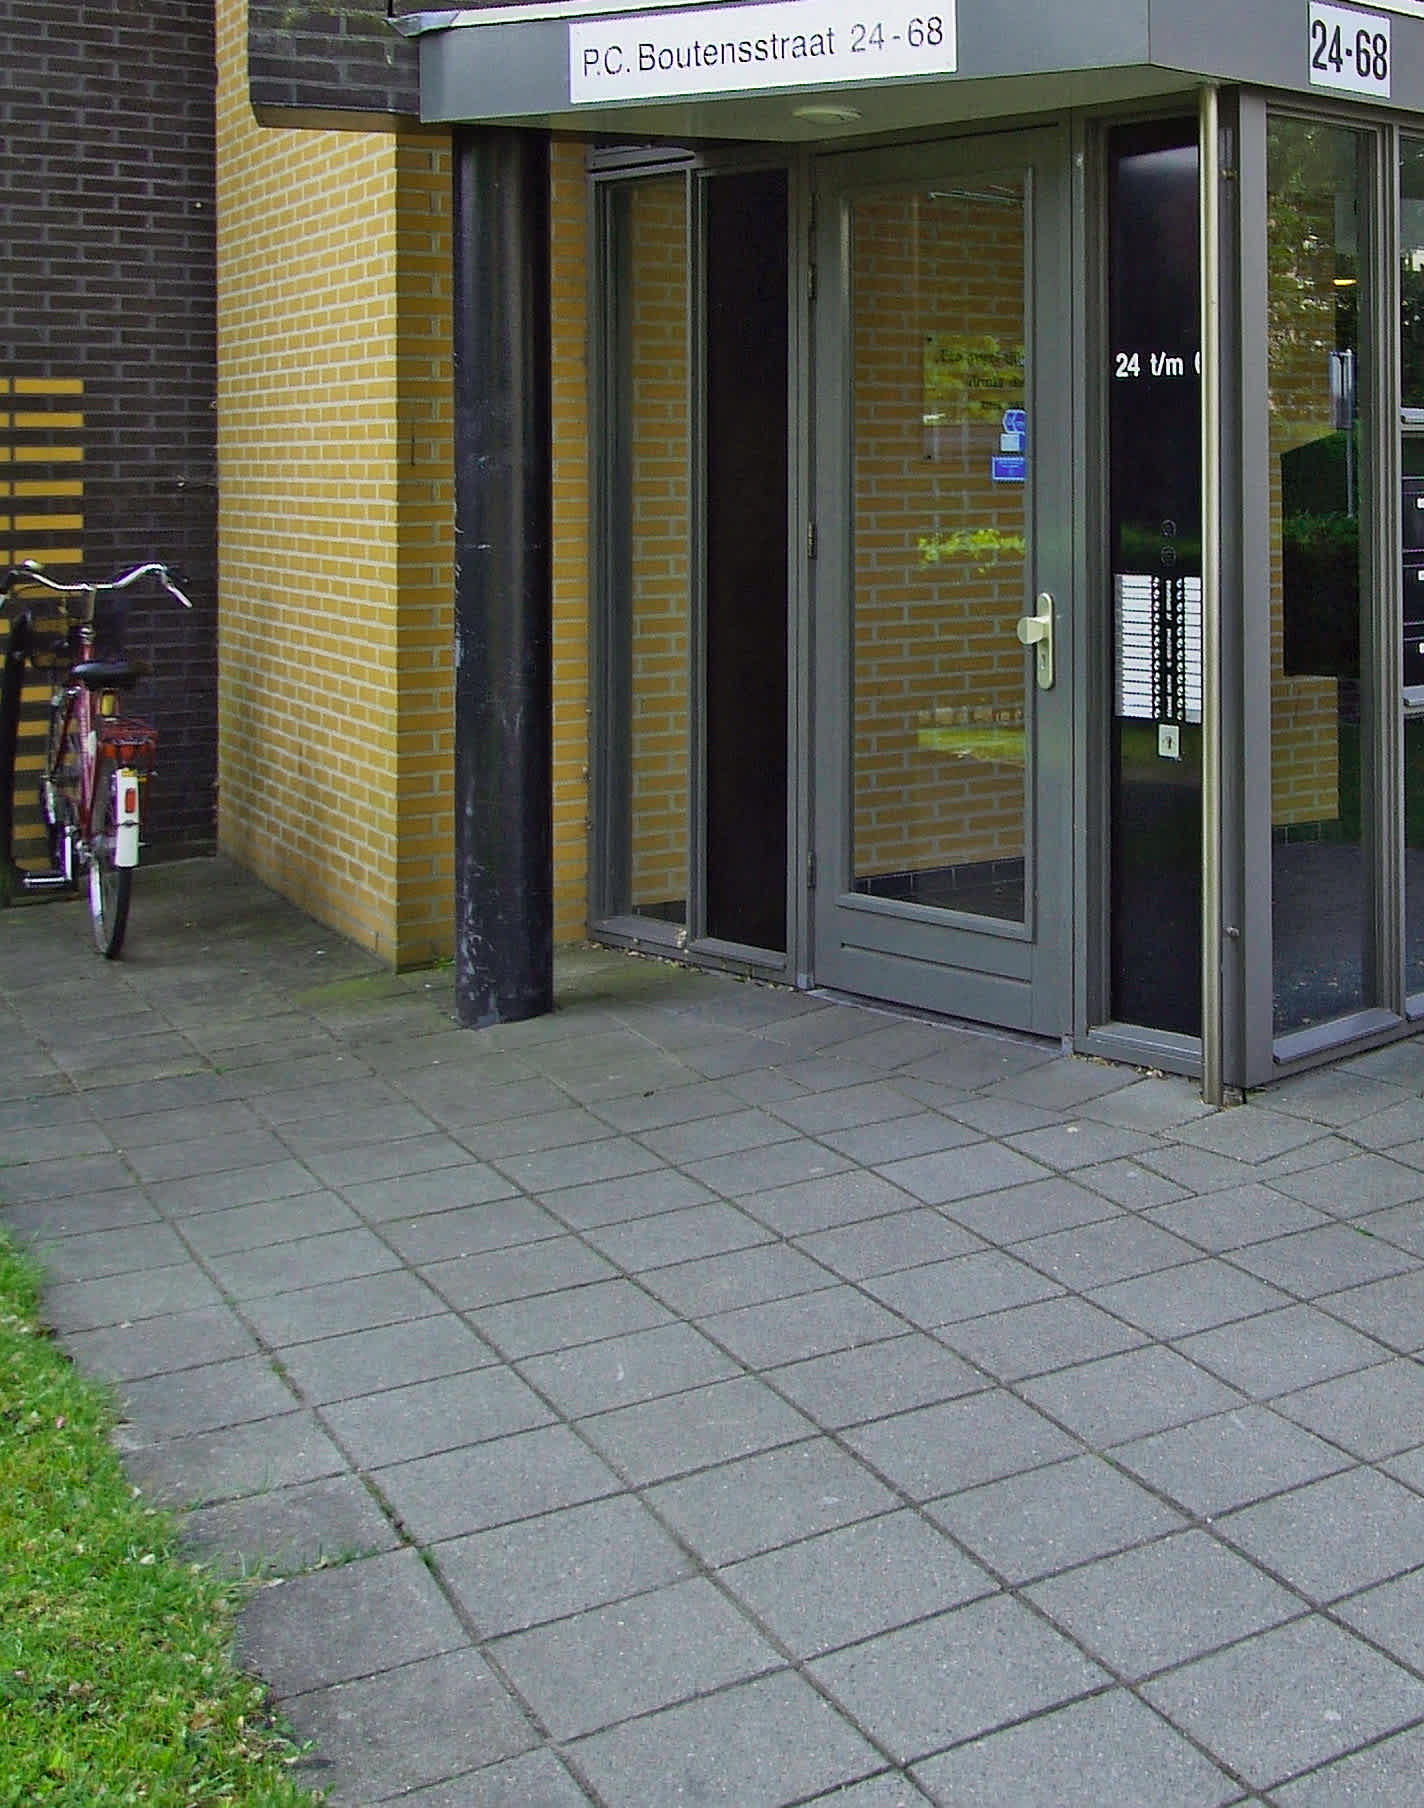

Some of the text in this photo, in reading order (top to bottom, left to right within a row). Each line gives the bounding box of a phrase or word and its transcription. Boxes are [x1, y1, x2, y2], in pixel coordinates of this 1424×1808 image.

[583, 45, 631, 78] P.C.
[638, 28, 836, 72] Boutensstraat
[1311, 19, 1388, 81] 24-68
[1115, 352, 1141, 378] 24
[1150, 351, 1184, 377] t/m
